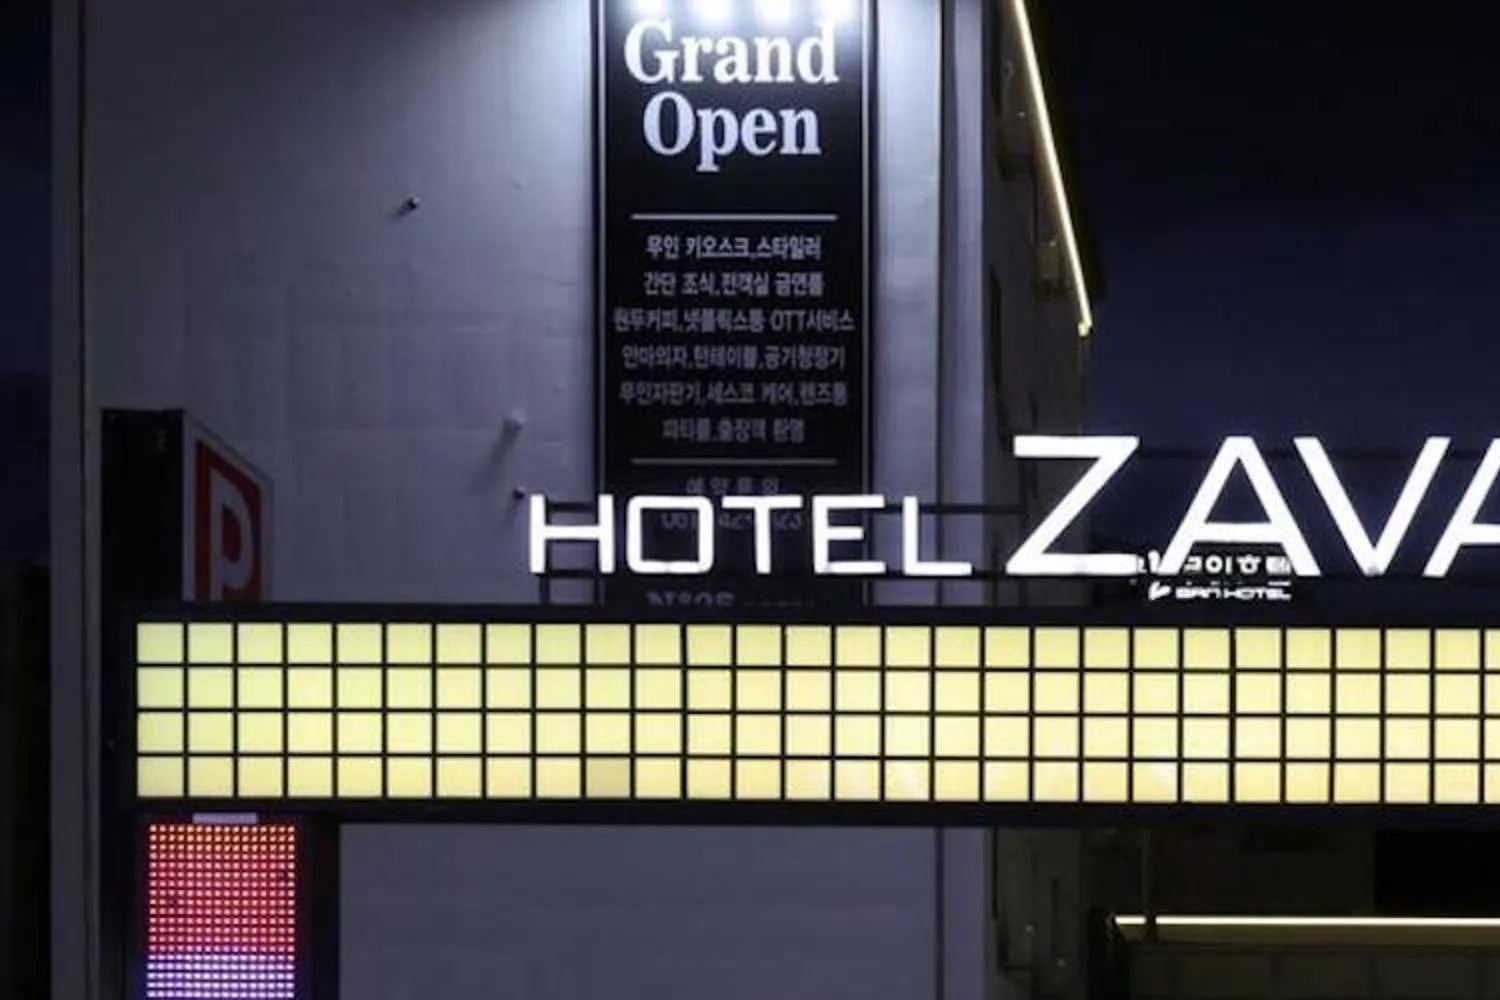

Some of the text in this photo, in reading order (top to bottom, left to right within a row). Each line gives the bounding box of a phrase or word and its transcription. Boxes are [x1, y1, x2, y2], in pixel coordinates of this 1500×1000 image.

[624, 20, 838, 84] Grand
[643, 91, 822, 172] Open
[646, 234, 681, 259] 무인
[529, 493, 973, 578] HOTEL
